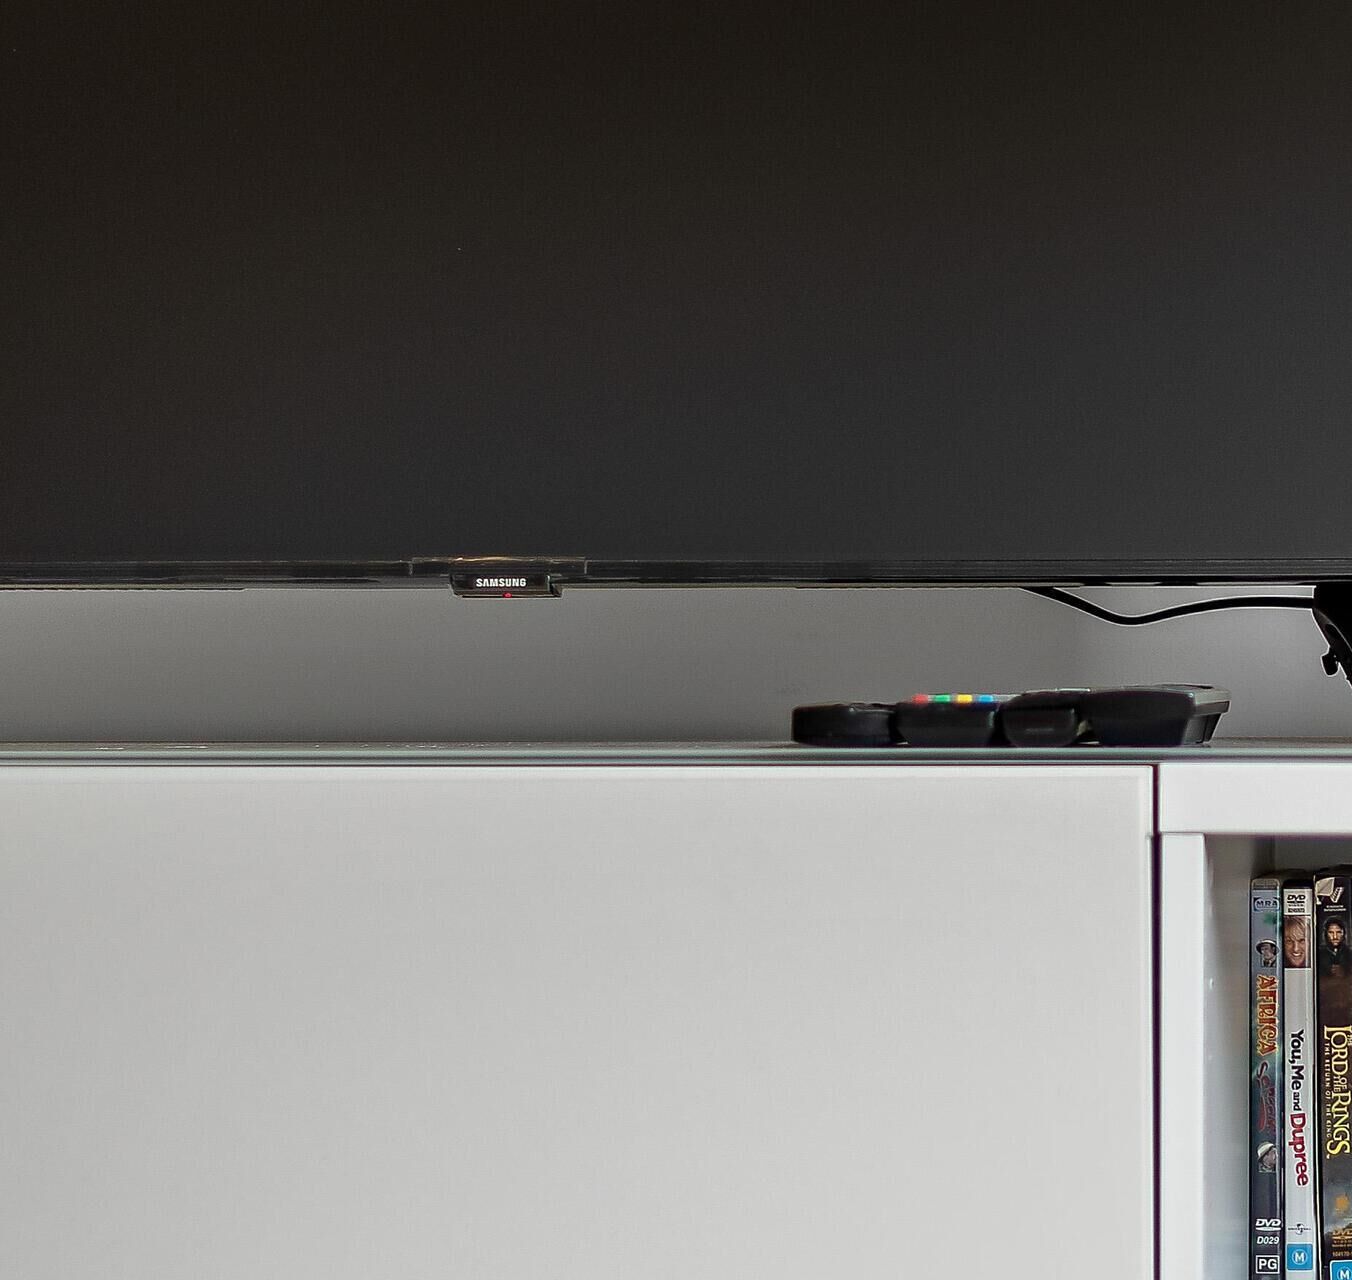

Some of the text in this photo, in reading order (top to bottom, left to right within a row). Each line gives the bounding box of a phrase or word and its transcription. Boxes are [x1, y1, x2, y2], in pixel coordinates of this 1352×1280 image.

[476, 578, 526, 587] SAMSUNG
[1256, 975, 1278, 1056] AFRICA
[1257, 1237, 1279, 1245] D029
